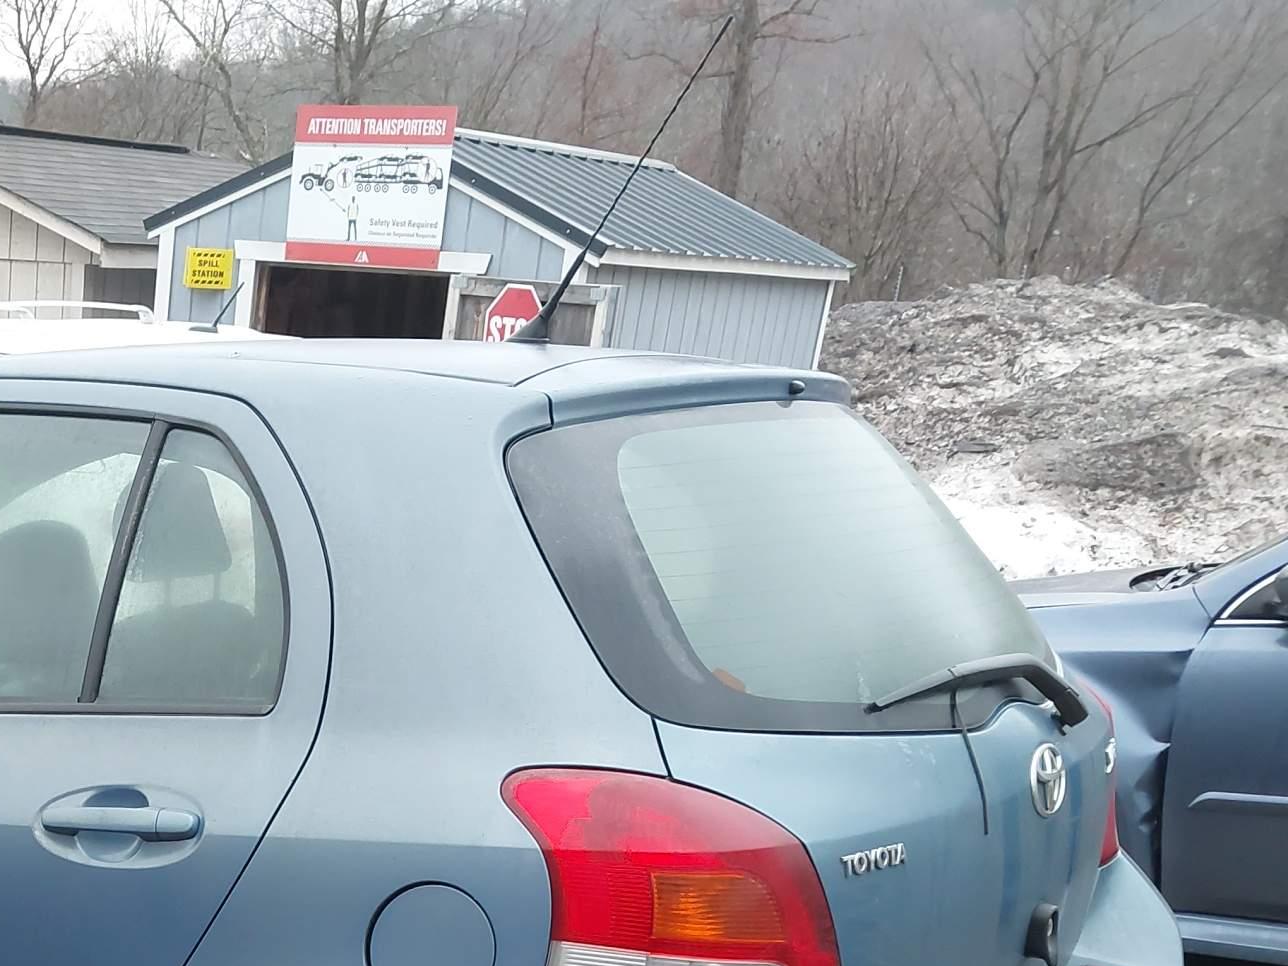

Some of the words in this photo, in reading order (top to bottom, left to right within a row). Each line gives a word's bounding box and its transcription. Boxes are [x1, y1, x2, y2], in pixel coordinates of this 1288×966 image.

[307, 118, 361, 135] ATTENTION
[362, 119, 447, 136] TRANSPORTERS!
[192, 270, 224, 278] STATION
[840, 843, 906, 877] TOYOTA
